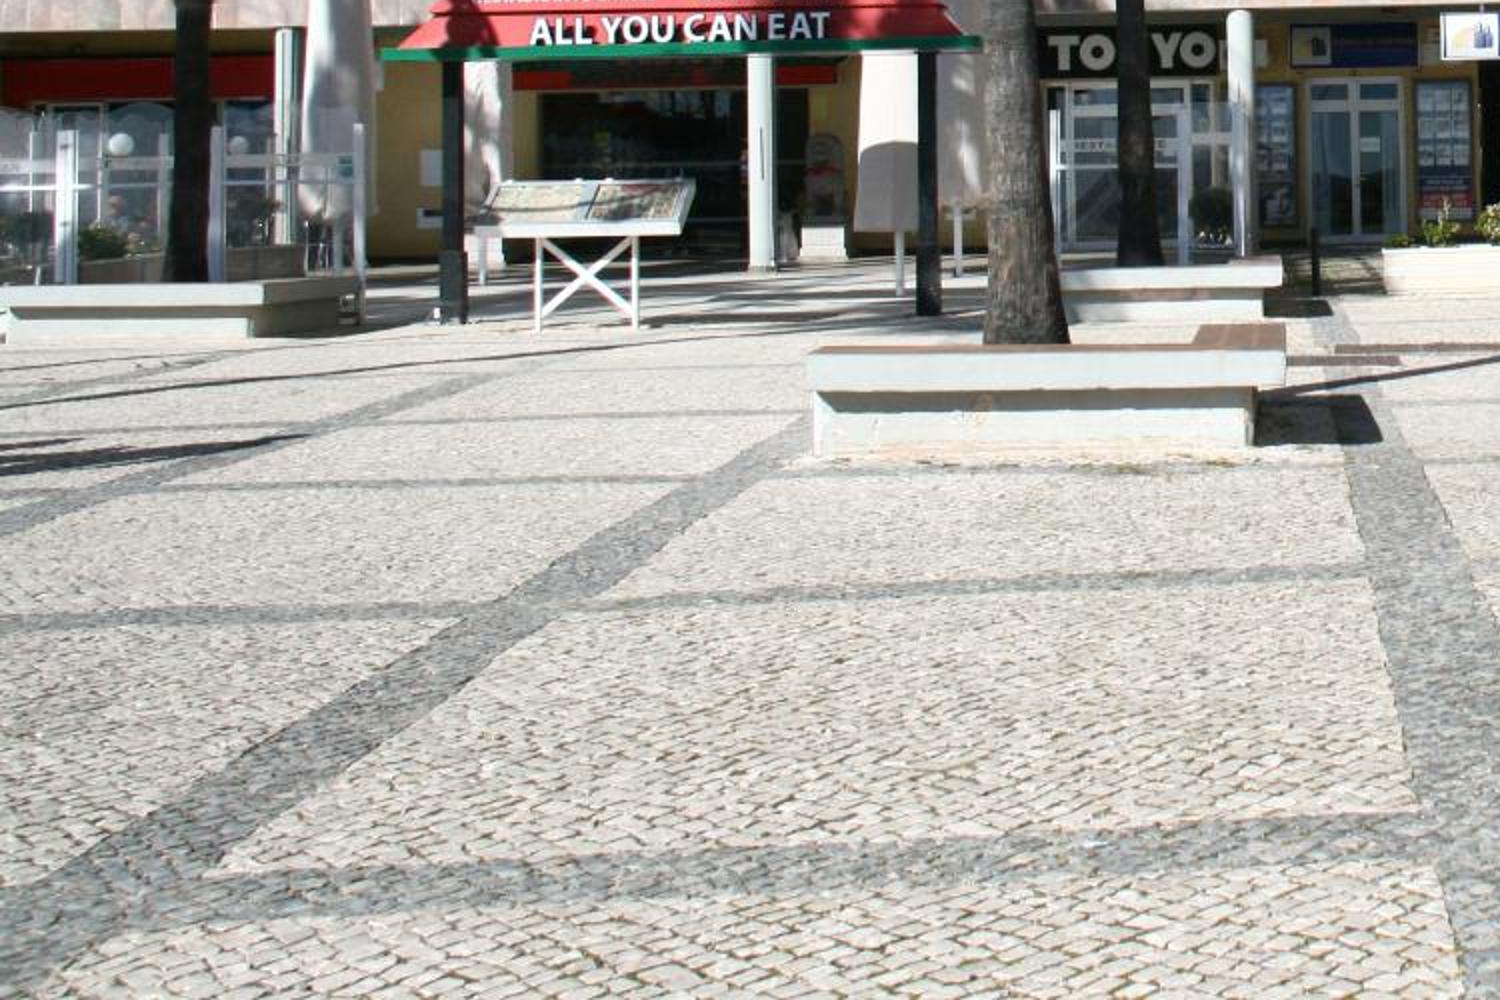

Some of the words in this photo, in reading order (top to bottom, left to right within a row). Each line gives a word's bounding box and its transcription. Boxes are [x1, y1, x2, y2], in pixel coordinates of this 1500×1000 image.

[528, 14, 593, 46] ALL
[600, 13, 675, 45] YOU
[682, 12, 758, 42] CAN
[767, 11, 831, 40] EAT
[1047, 30, 1217, 72] TOYO
